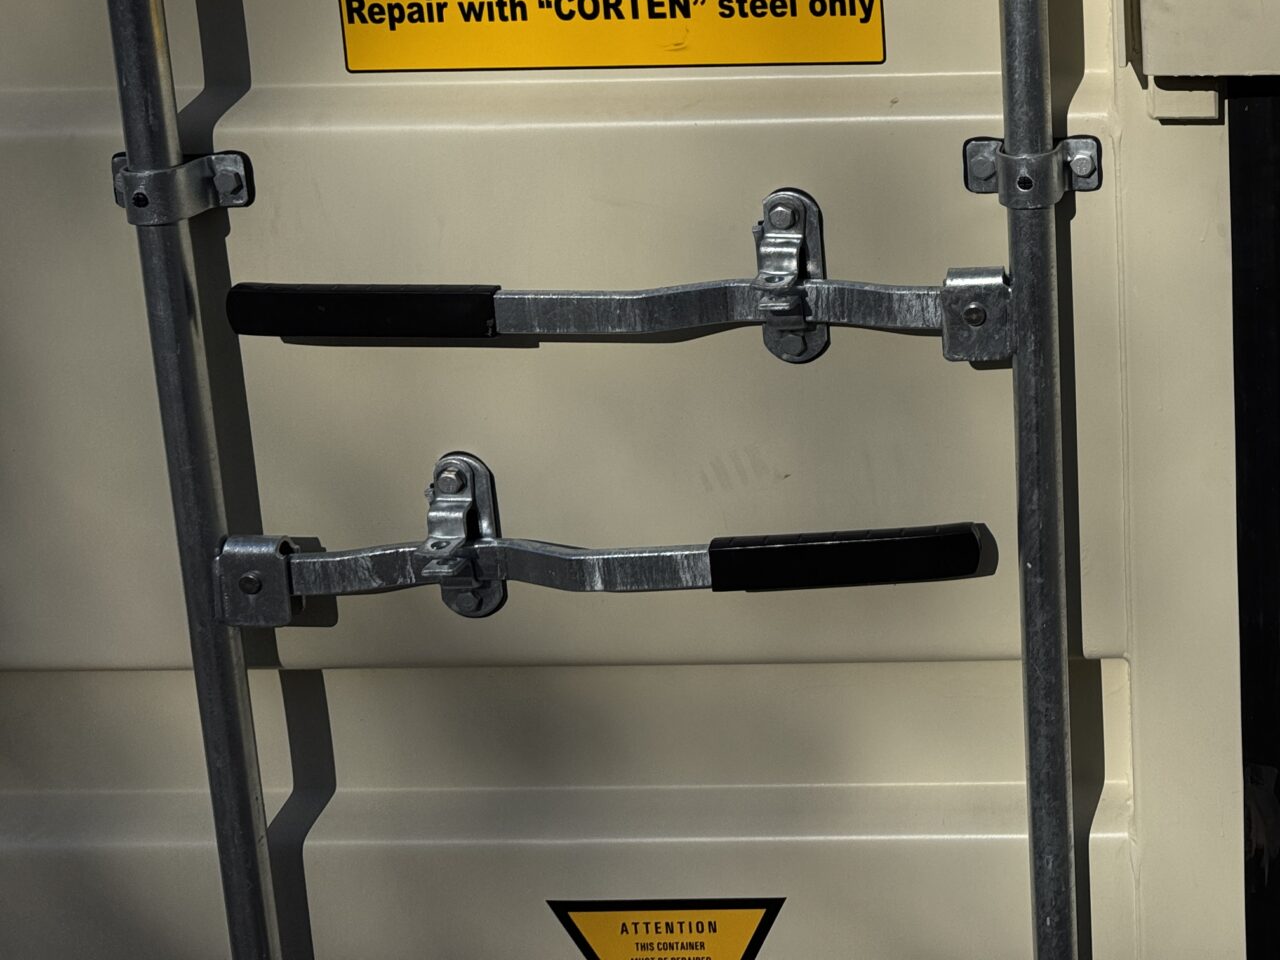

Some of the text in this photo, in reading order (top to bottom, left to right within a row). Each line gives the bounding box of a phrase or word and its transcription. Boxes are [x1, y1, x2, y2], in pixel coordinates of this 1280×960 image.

[620, 921, 717, 935] ATTENTION
[635, 941, 705, 951] THIS CONTAINER
